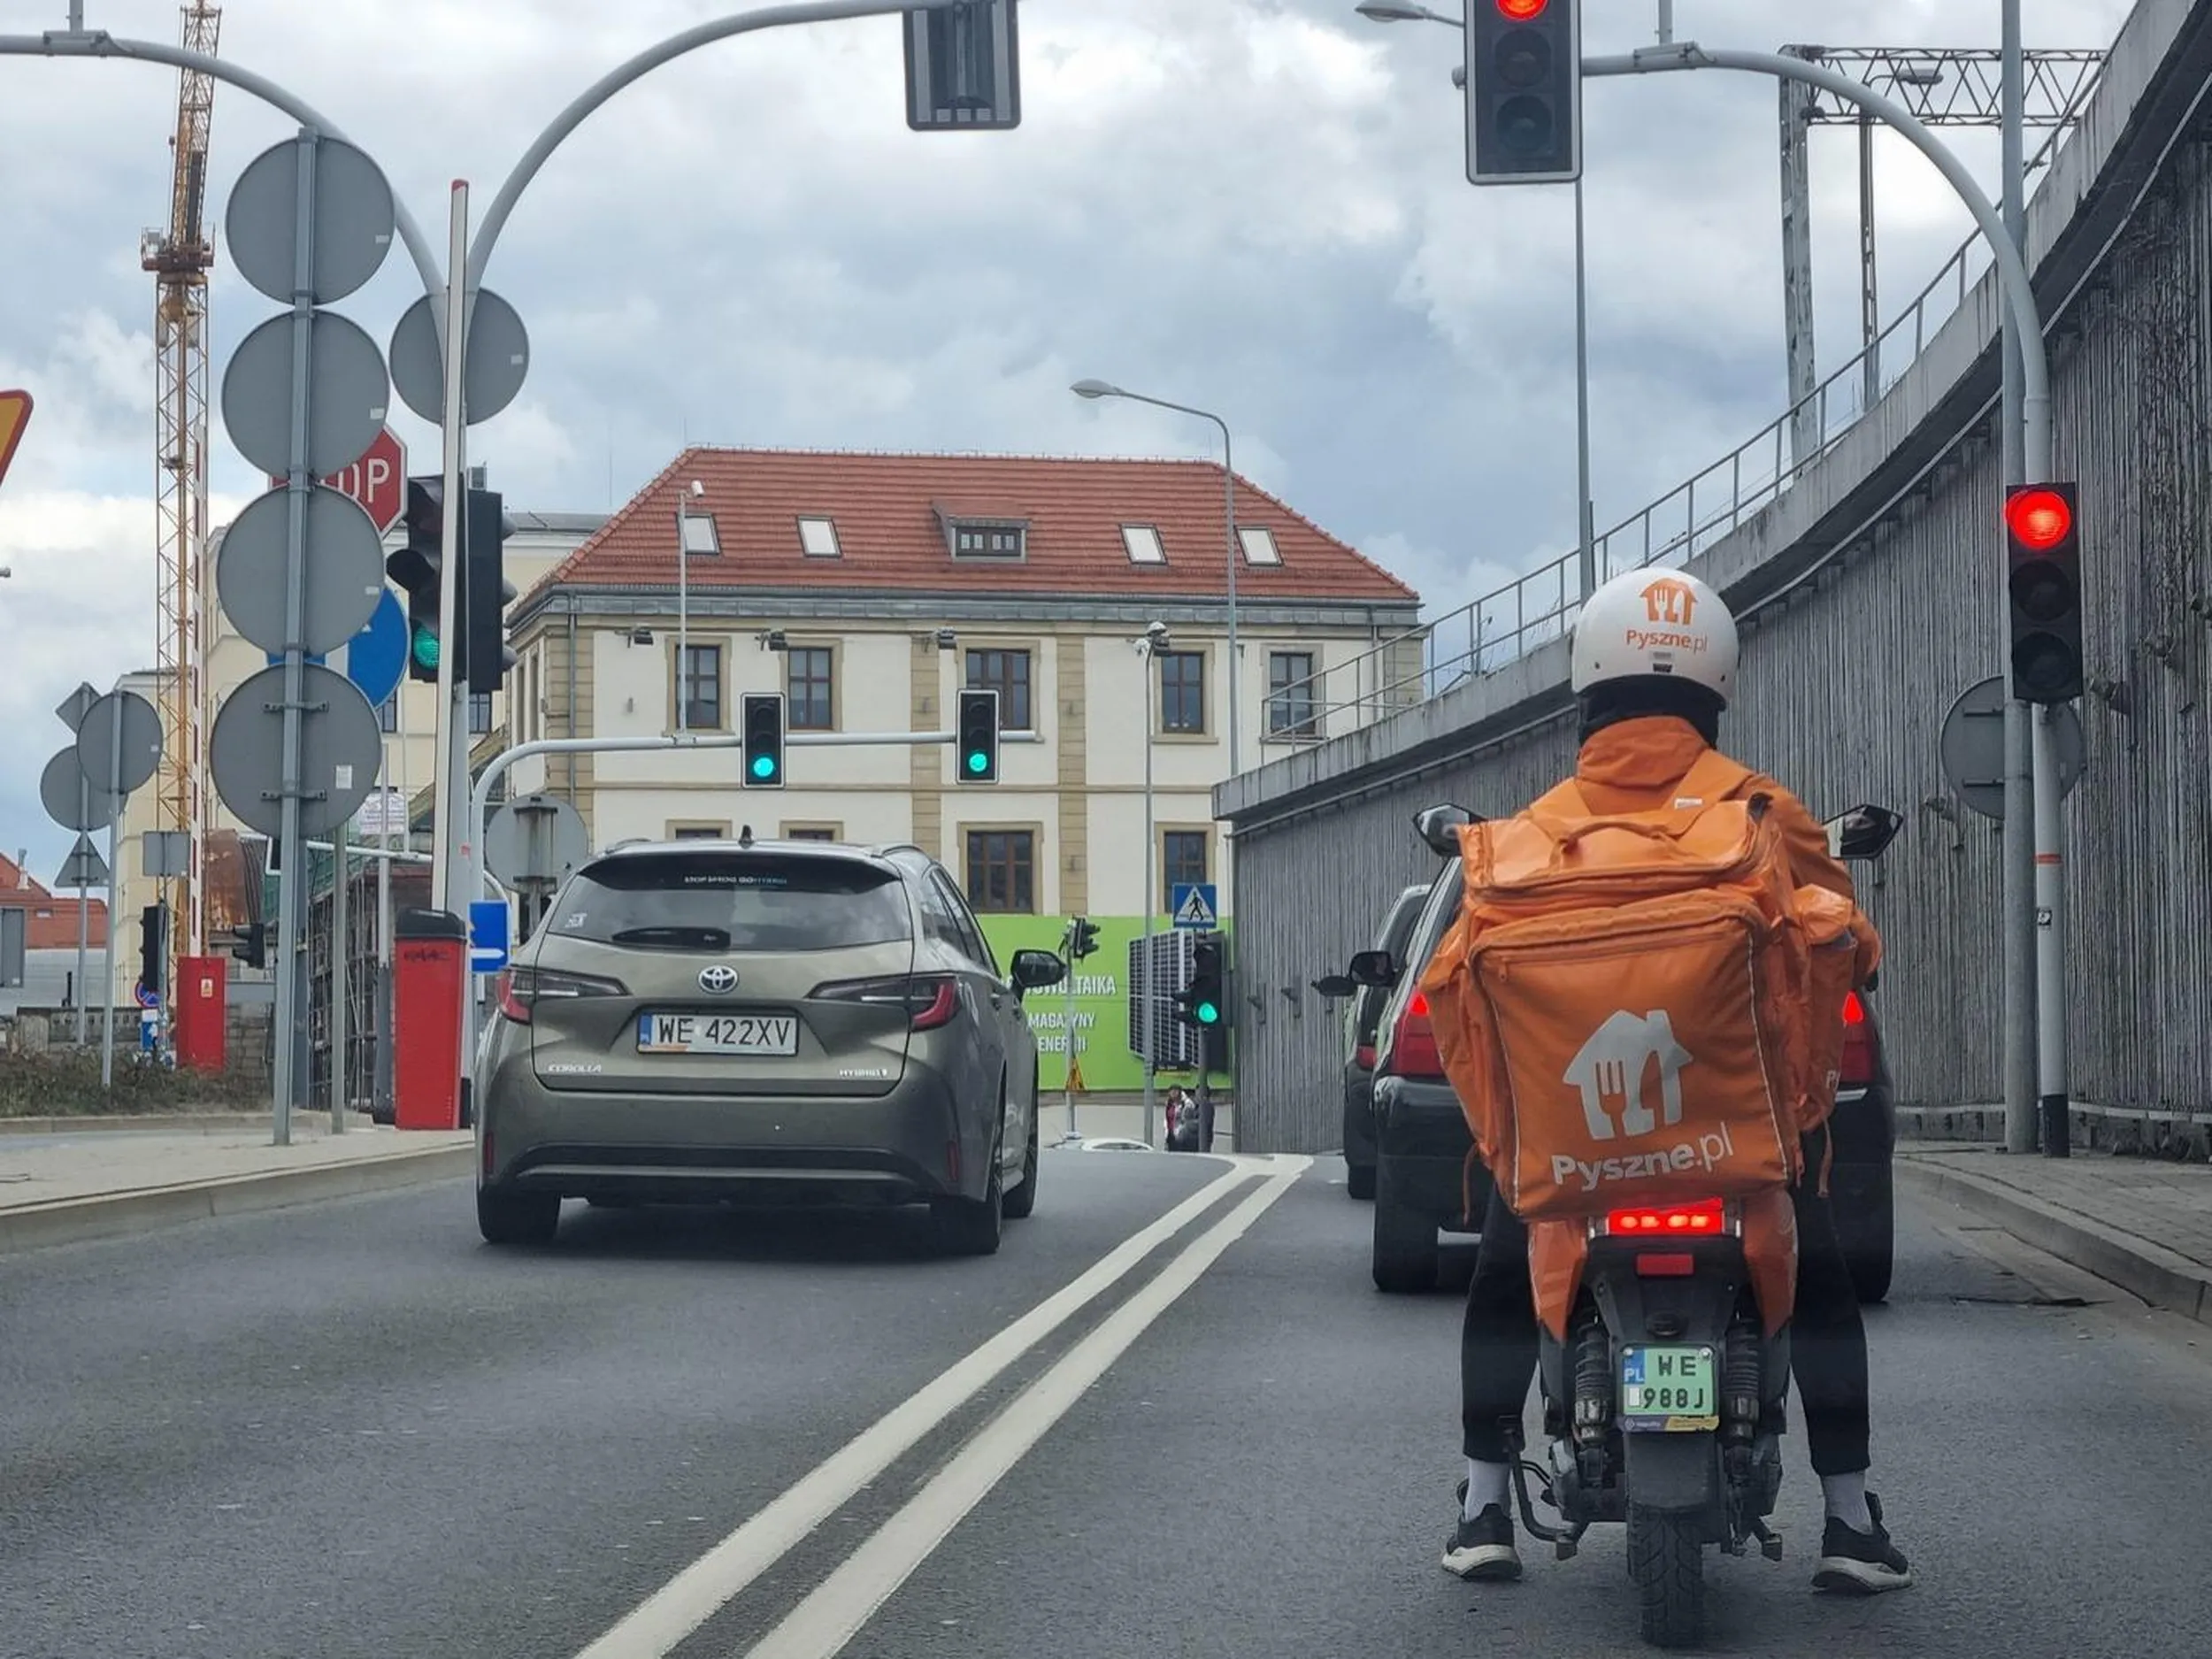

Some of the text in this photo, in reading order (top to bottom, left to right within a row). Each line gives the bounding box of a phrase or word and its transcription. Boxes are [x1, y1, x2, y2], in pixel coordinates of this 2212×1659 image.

[319, 458, 390, 503] OP
[1625, 629, 1708, 655] Pyszne.pl
[658, 1018, 694, 1044] WE
[705, 1018, 790, 1046] 422XV
[1027, 1011, 1095, 1028] MAGAYNY
[1038, 1036, 1087, 1052] ENERII
[1550, 1121, 1735, 1193] Pyszne.pl
[1624, 1355, 1697, 1383] PL WE
[1643, 1387, 1704, 1409] 988J
